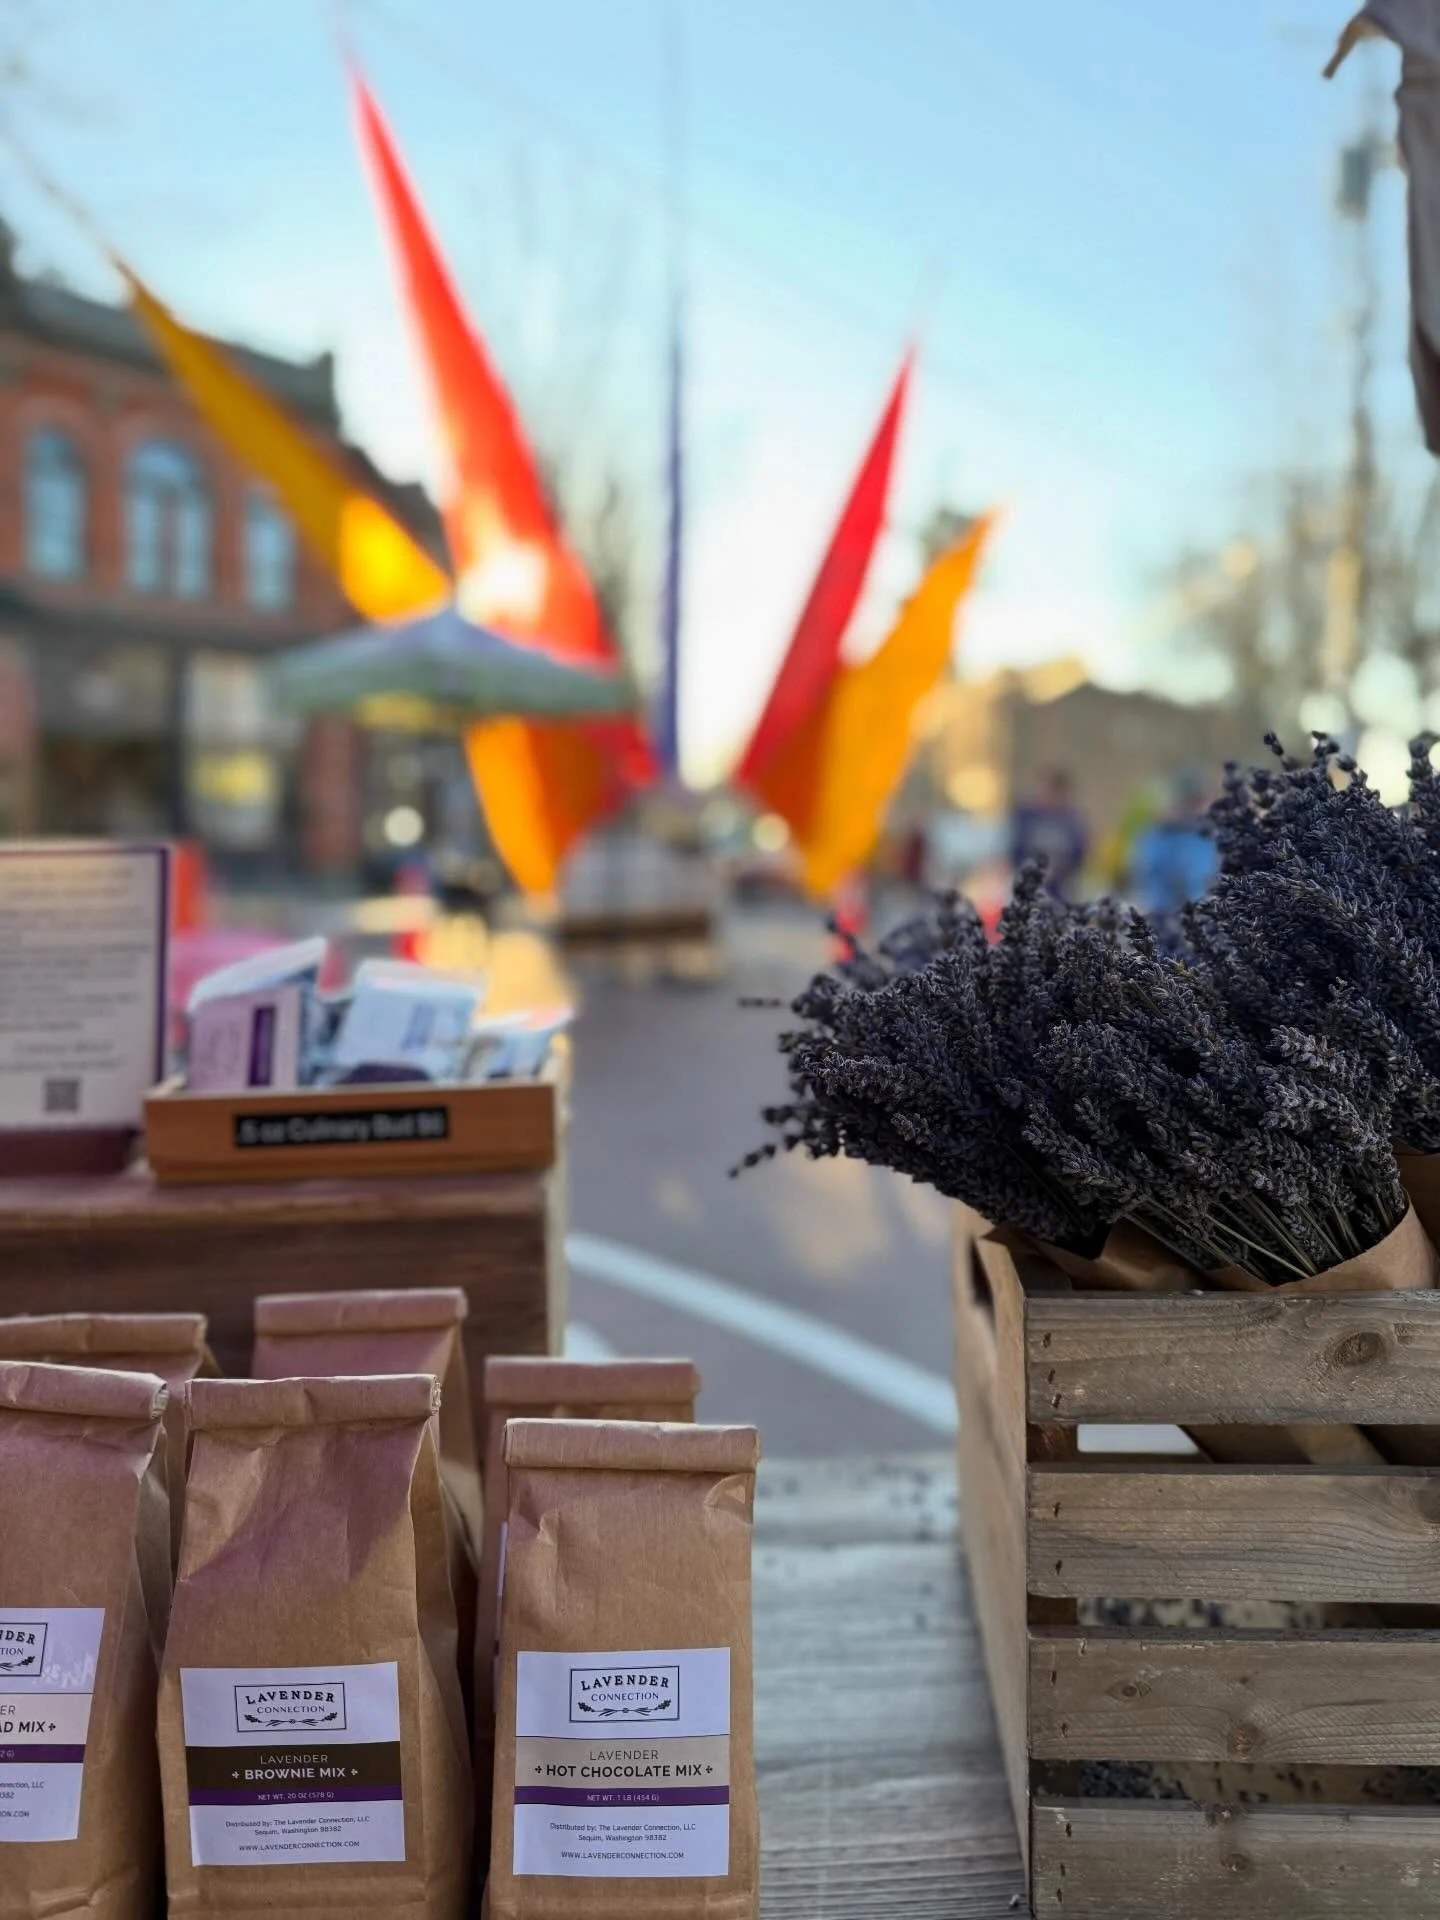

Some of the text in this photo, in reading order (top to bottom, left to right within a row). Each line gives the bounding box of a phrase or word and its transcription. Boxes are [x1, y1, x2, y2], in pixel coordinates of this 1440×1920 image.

[580, 1675, 669, 1691] LAVENDER
[245, 1691, 334, 1705] LAVENDER
[591, 1692, 659, 1702] CONNECTION
[256, 1705, 325, 1714] CONNECTION
[18, 1721, 46, 1734] MIX
[260, 1754, 329, 1765] LAVENDER
[589, 1750, 659, 1761] LAVENDER
[244, 1767, 347, 1780] BROWNIE MIX
[546, 1764, 702, 1778] HOT CHOCOLATE MIX
[633, 1794, 650, 1802] (454
[287, 1817, 317, 1825] Lavender
[357, 1815, 370, 1823] LLC
[281, 1827, 319, 1835] Washington
[550, 1822, 585, 1831] Distributed
[643, 1824, 682, 1832] Connection,
[683, 1823, 696, 1831] LLC
[578, 1834, 604, 1842] Sequim,
[605, 1834, 644, 1843] Washington
[239, 1840, 360, 1851] WWW.LAVENDERCONNECTION.COM
[561, 1851, 684, 1859] WWW.LAVENDERCONNECTION.COM
